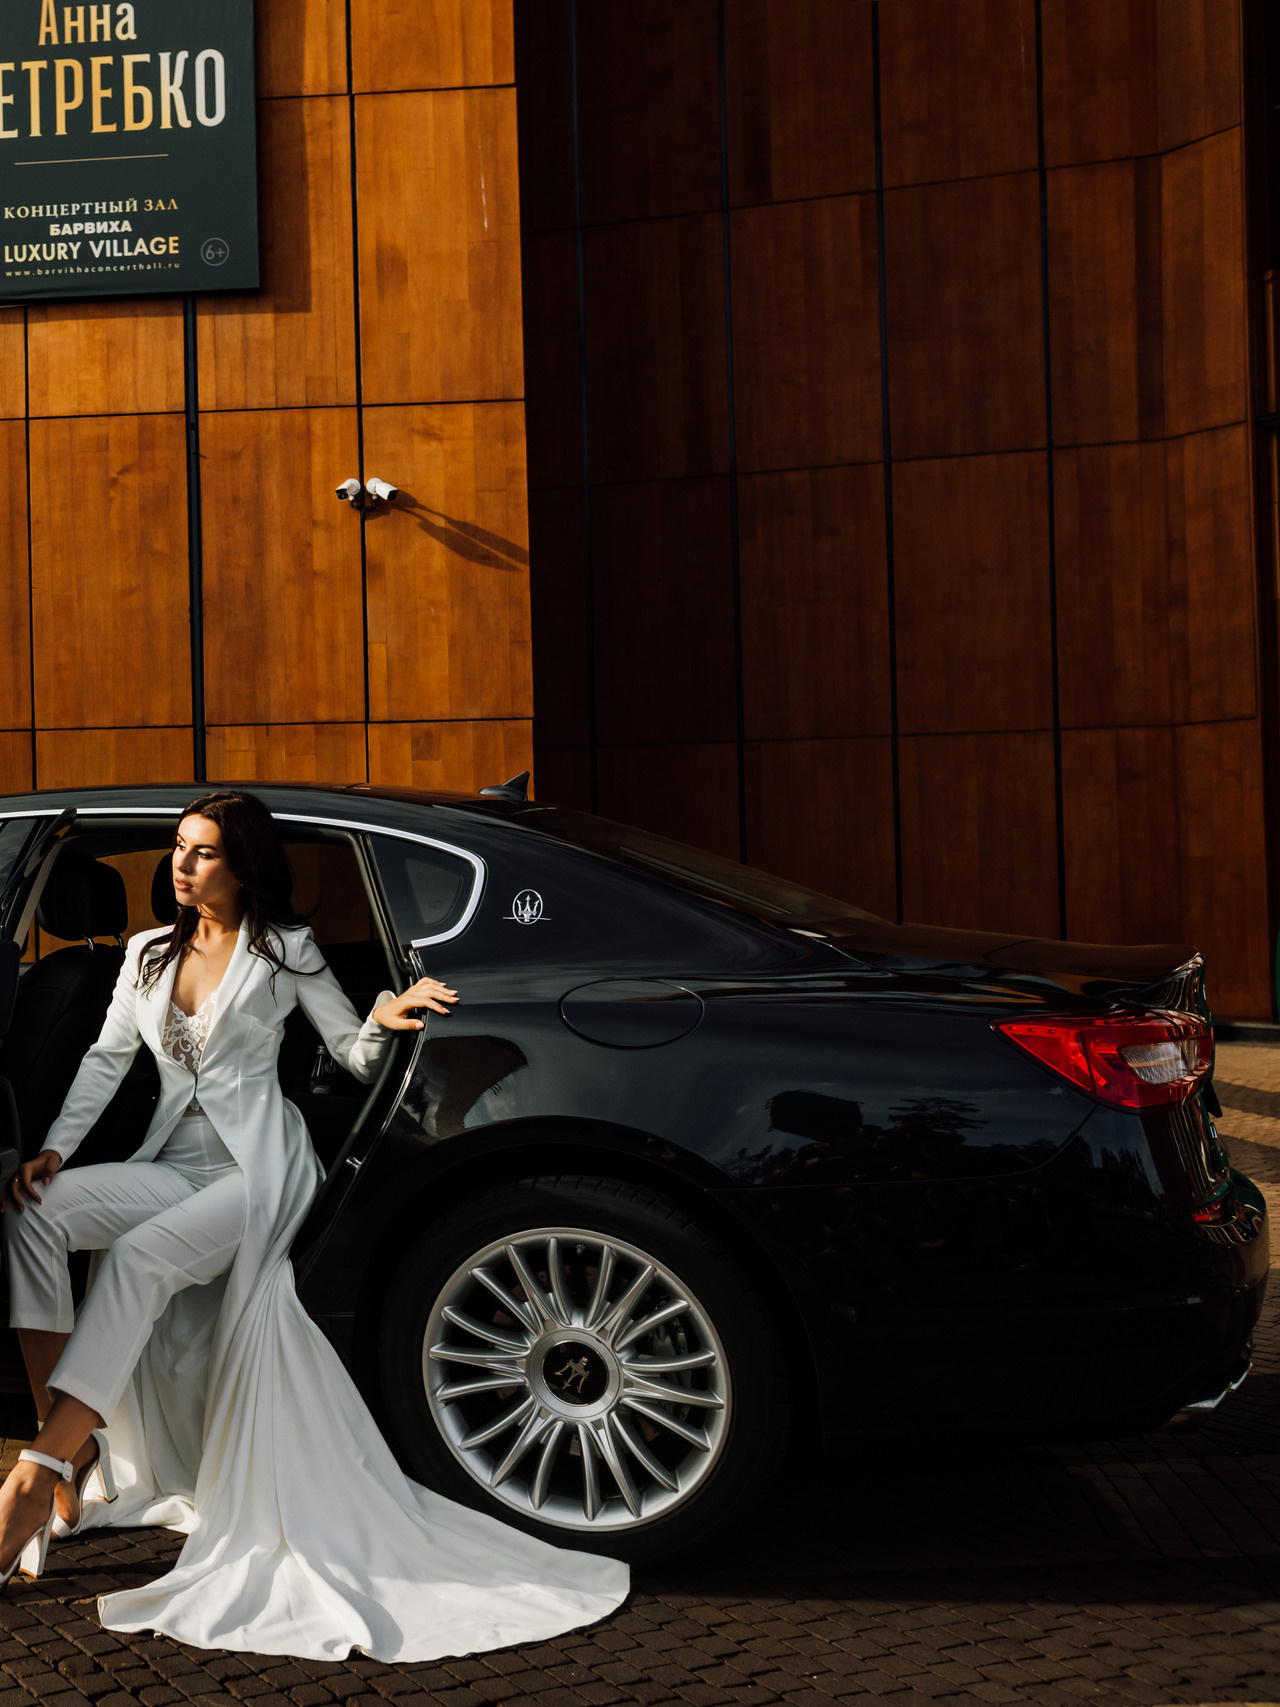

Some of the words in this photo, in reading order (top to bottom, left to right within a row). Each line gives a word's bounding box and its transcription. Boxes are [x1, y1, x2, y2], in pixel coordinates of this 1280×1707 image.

[38, 0, 137, 46] Анна
[4, 198, 138, 219] КОНЦЕРТНЫЙ
[144, 198, 179, 212] ЗАЛ
[49, 220, 133, 236] БАРВИХА
[4, 241, 82, 263] LUXURY
[89, 236, 180, 259] VILLAGE
[205, 244, 225, 260] 6+
[5, 262, 180, 277] www.barvikhaconcerthall.ru
